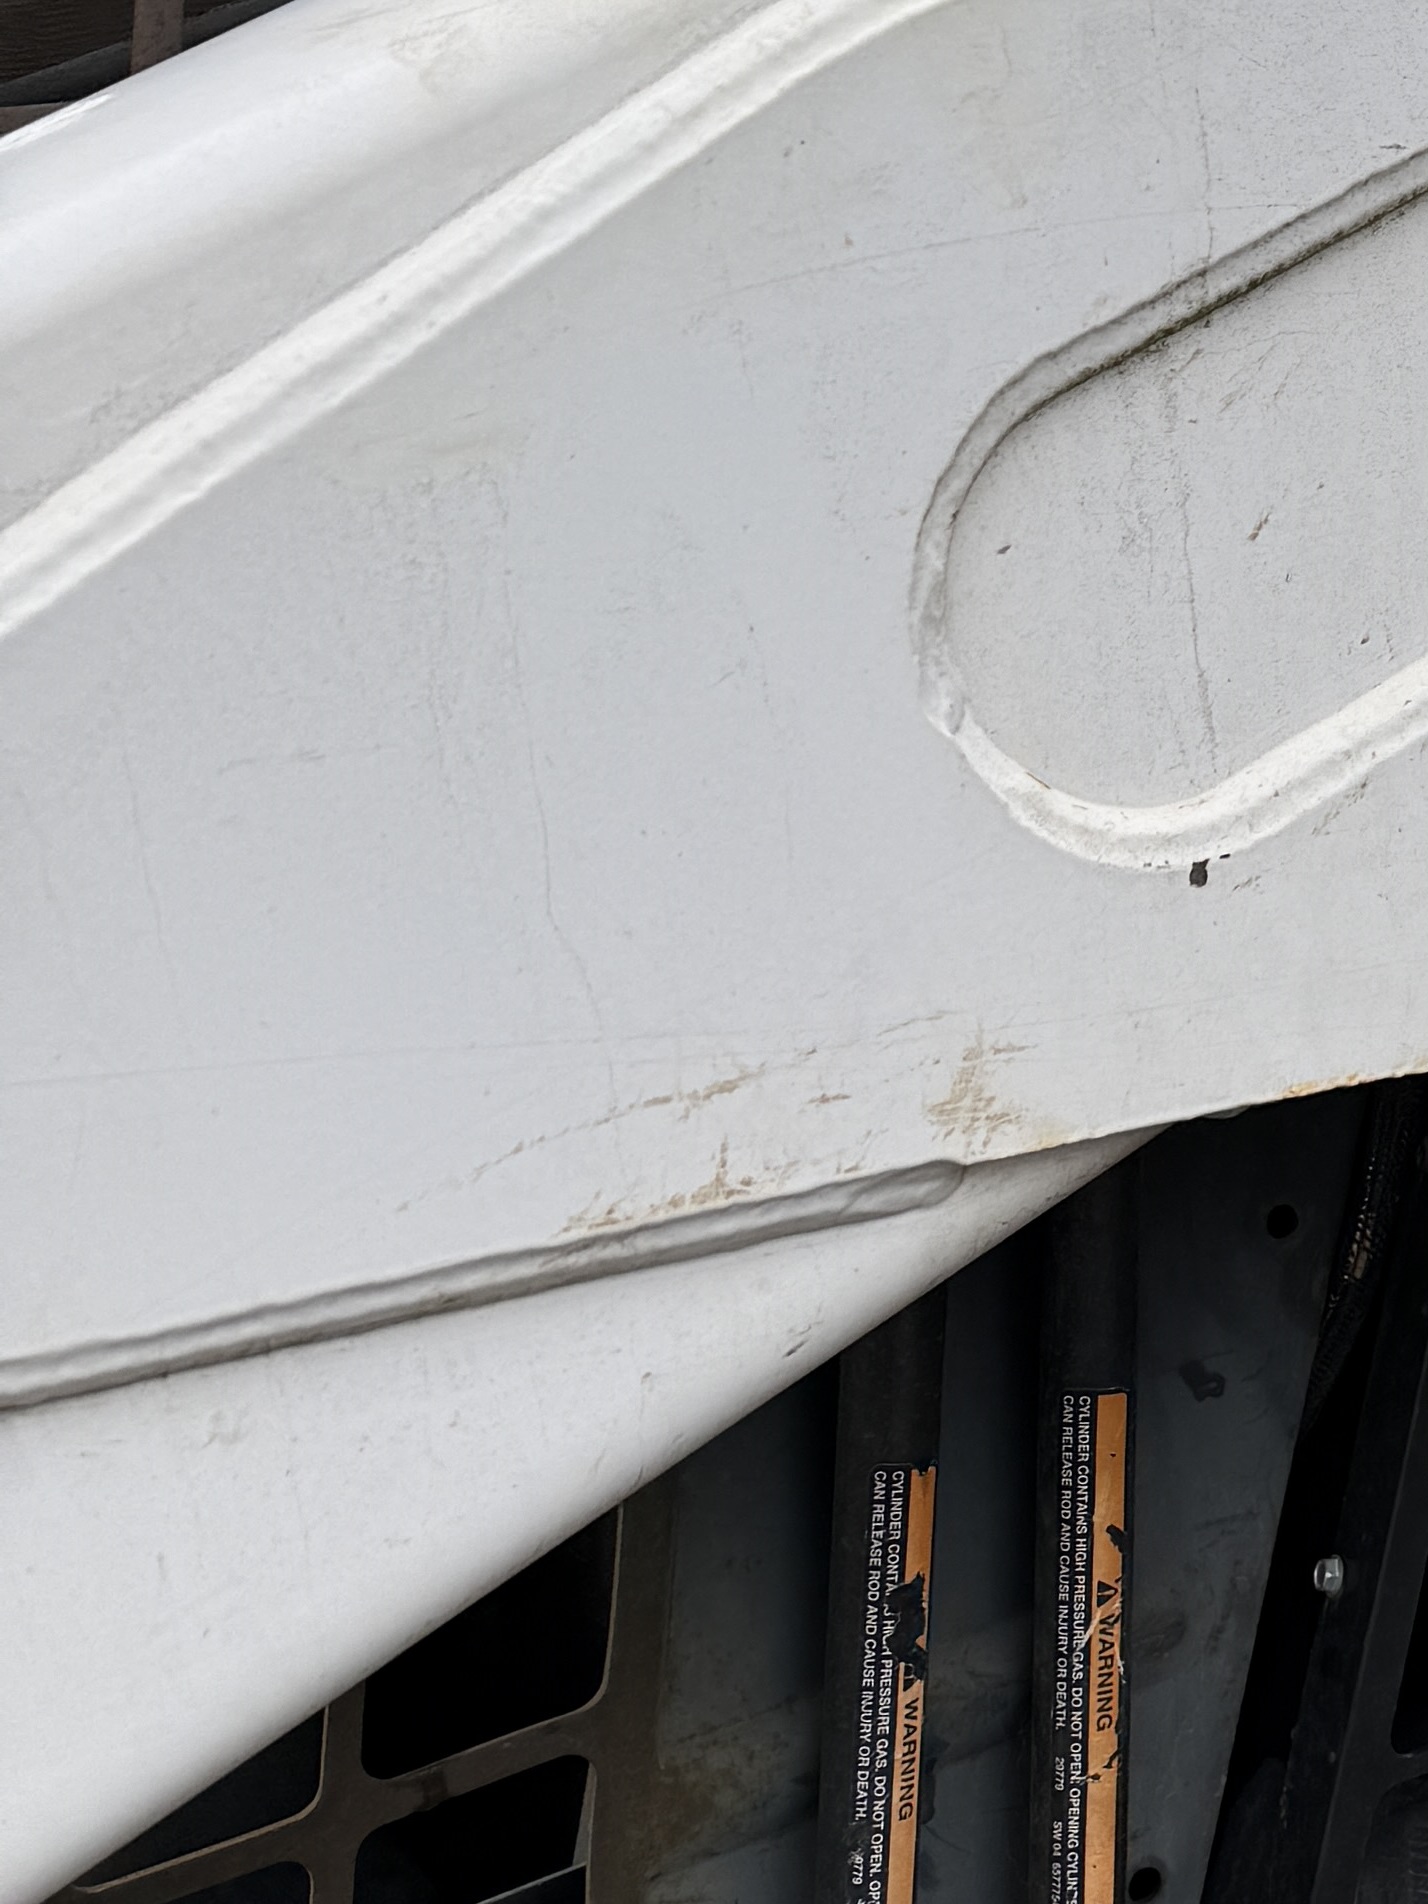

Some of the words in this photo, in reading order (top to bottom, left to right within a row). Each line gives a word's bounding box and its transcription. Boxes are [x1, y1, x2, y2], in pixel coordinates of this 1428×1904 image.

[1062, 1395, 1074, 1423] CAN
[1077, 1395, 1091, 1462] CYLINDER
[1061, 1426, 1073, 1486] RELEASE
[874, 1470, 887, 1500] CAN
[1075, 1465, 1089, 1534] CONTAINS
[888, 1470, 904, 1540] CYLINDER
[1060, 1490, 1072, 1520] ROD
[869, 1504, 884, 1566] RELEASE
[1060, 1523, 1071, 1552] AND
[1075, 1538, 1087, 1571] HIGH
[867, 1570, 881, 1601] ROD
[1059, 1555, 1071, 1601] CAUSE
[865, 1605, 878, 1635] AND
[1057, 1605, 1069, 1654] INJURY
[1073, 1575, 1086, 1648] PRESSURE
[862, 1639, 877, 1687] CAUSE
[1056, 1657, 1067, 1678] OR
[1071, 1651, 1083, 1683] GAS.
[1096, 1613, 1116, 1732] WARNING
[859, 1691, 873, 1741] INJURY
[877, 1660, 892, 1734] PRESSURE
[1055, 1681, 1067, 1731] DEATH.
[1070, 1687, 1082, 1707] DO
[1070, 1710, 1082, 1739] NOT
[858, 1746, 870, 1767] OR
[874, 1739, 888, 1772] GAS.
[899, 1697, 919, 1821] WARNING
[855, 1771, 869, 1821] DEATH.
[873, 1776, 887, 1797] DO
[872, 1800, 886, 1830] NOT
[1052, 1821, 1063, 1841] SW
[1067, 1788, 1080, 1848] OPENING
[869, 1834, 883, 1877] OPEN.
[1052, 1843, 1063, 1856] 04
